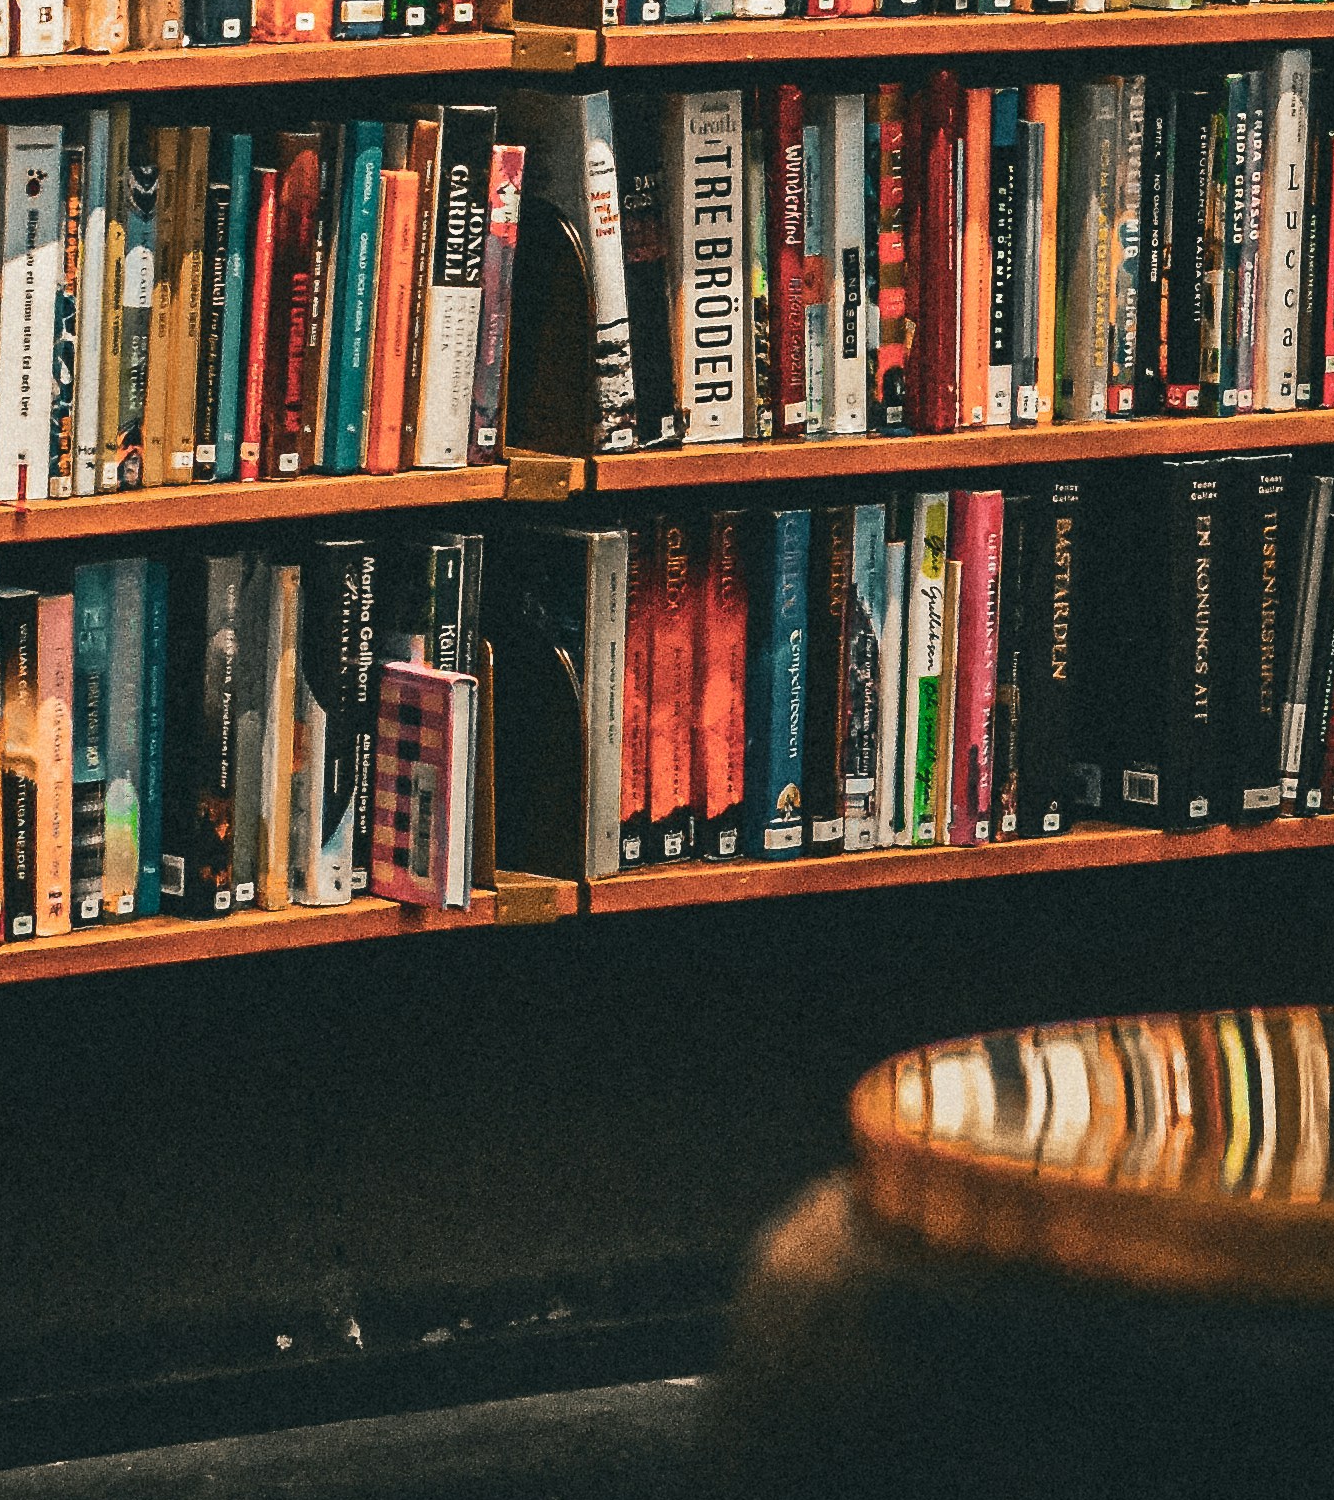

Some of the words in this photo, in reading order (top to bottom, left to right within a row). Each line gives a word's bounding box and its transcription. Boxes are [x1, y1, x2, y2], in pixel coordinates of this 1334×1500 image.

[1235, 113, 1246, 165] FRIDA
[1252, 110, 1262, 160] FRIDA
[444, 165, 468, 281] GARDELL
[695, 149, 731, 225] TRE
[785, 144, 800, 245] Wunderkind
[465, 202, 484, 281] JONAS
[1282, 165, 1299, 347] Lucca
[695, 238, 737, 405] BRÖDER
[360, 557, 374, 621] Martha
[923, 587, 943, 670] Gulliksen
[1051, 518, 1073, 679] BASTARDEN
[358, 627, 373, 702] Gellhorn
